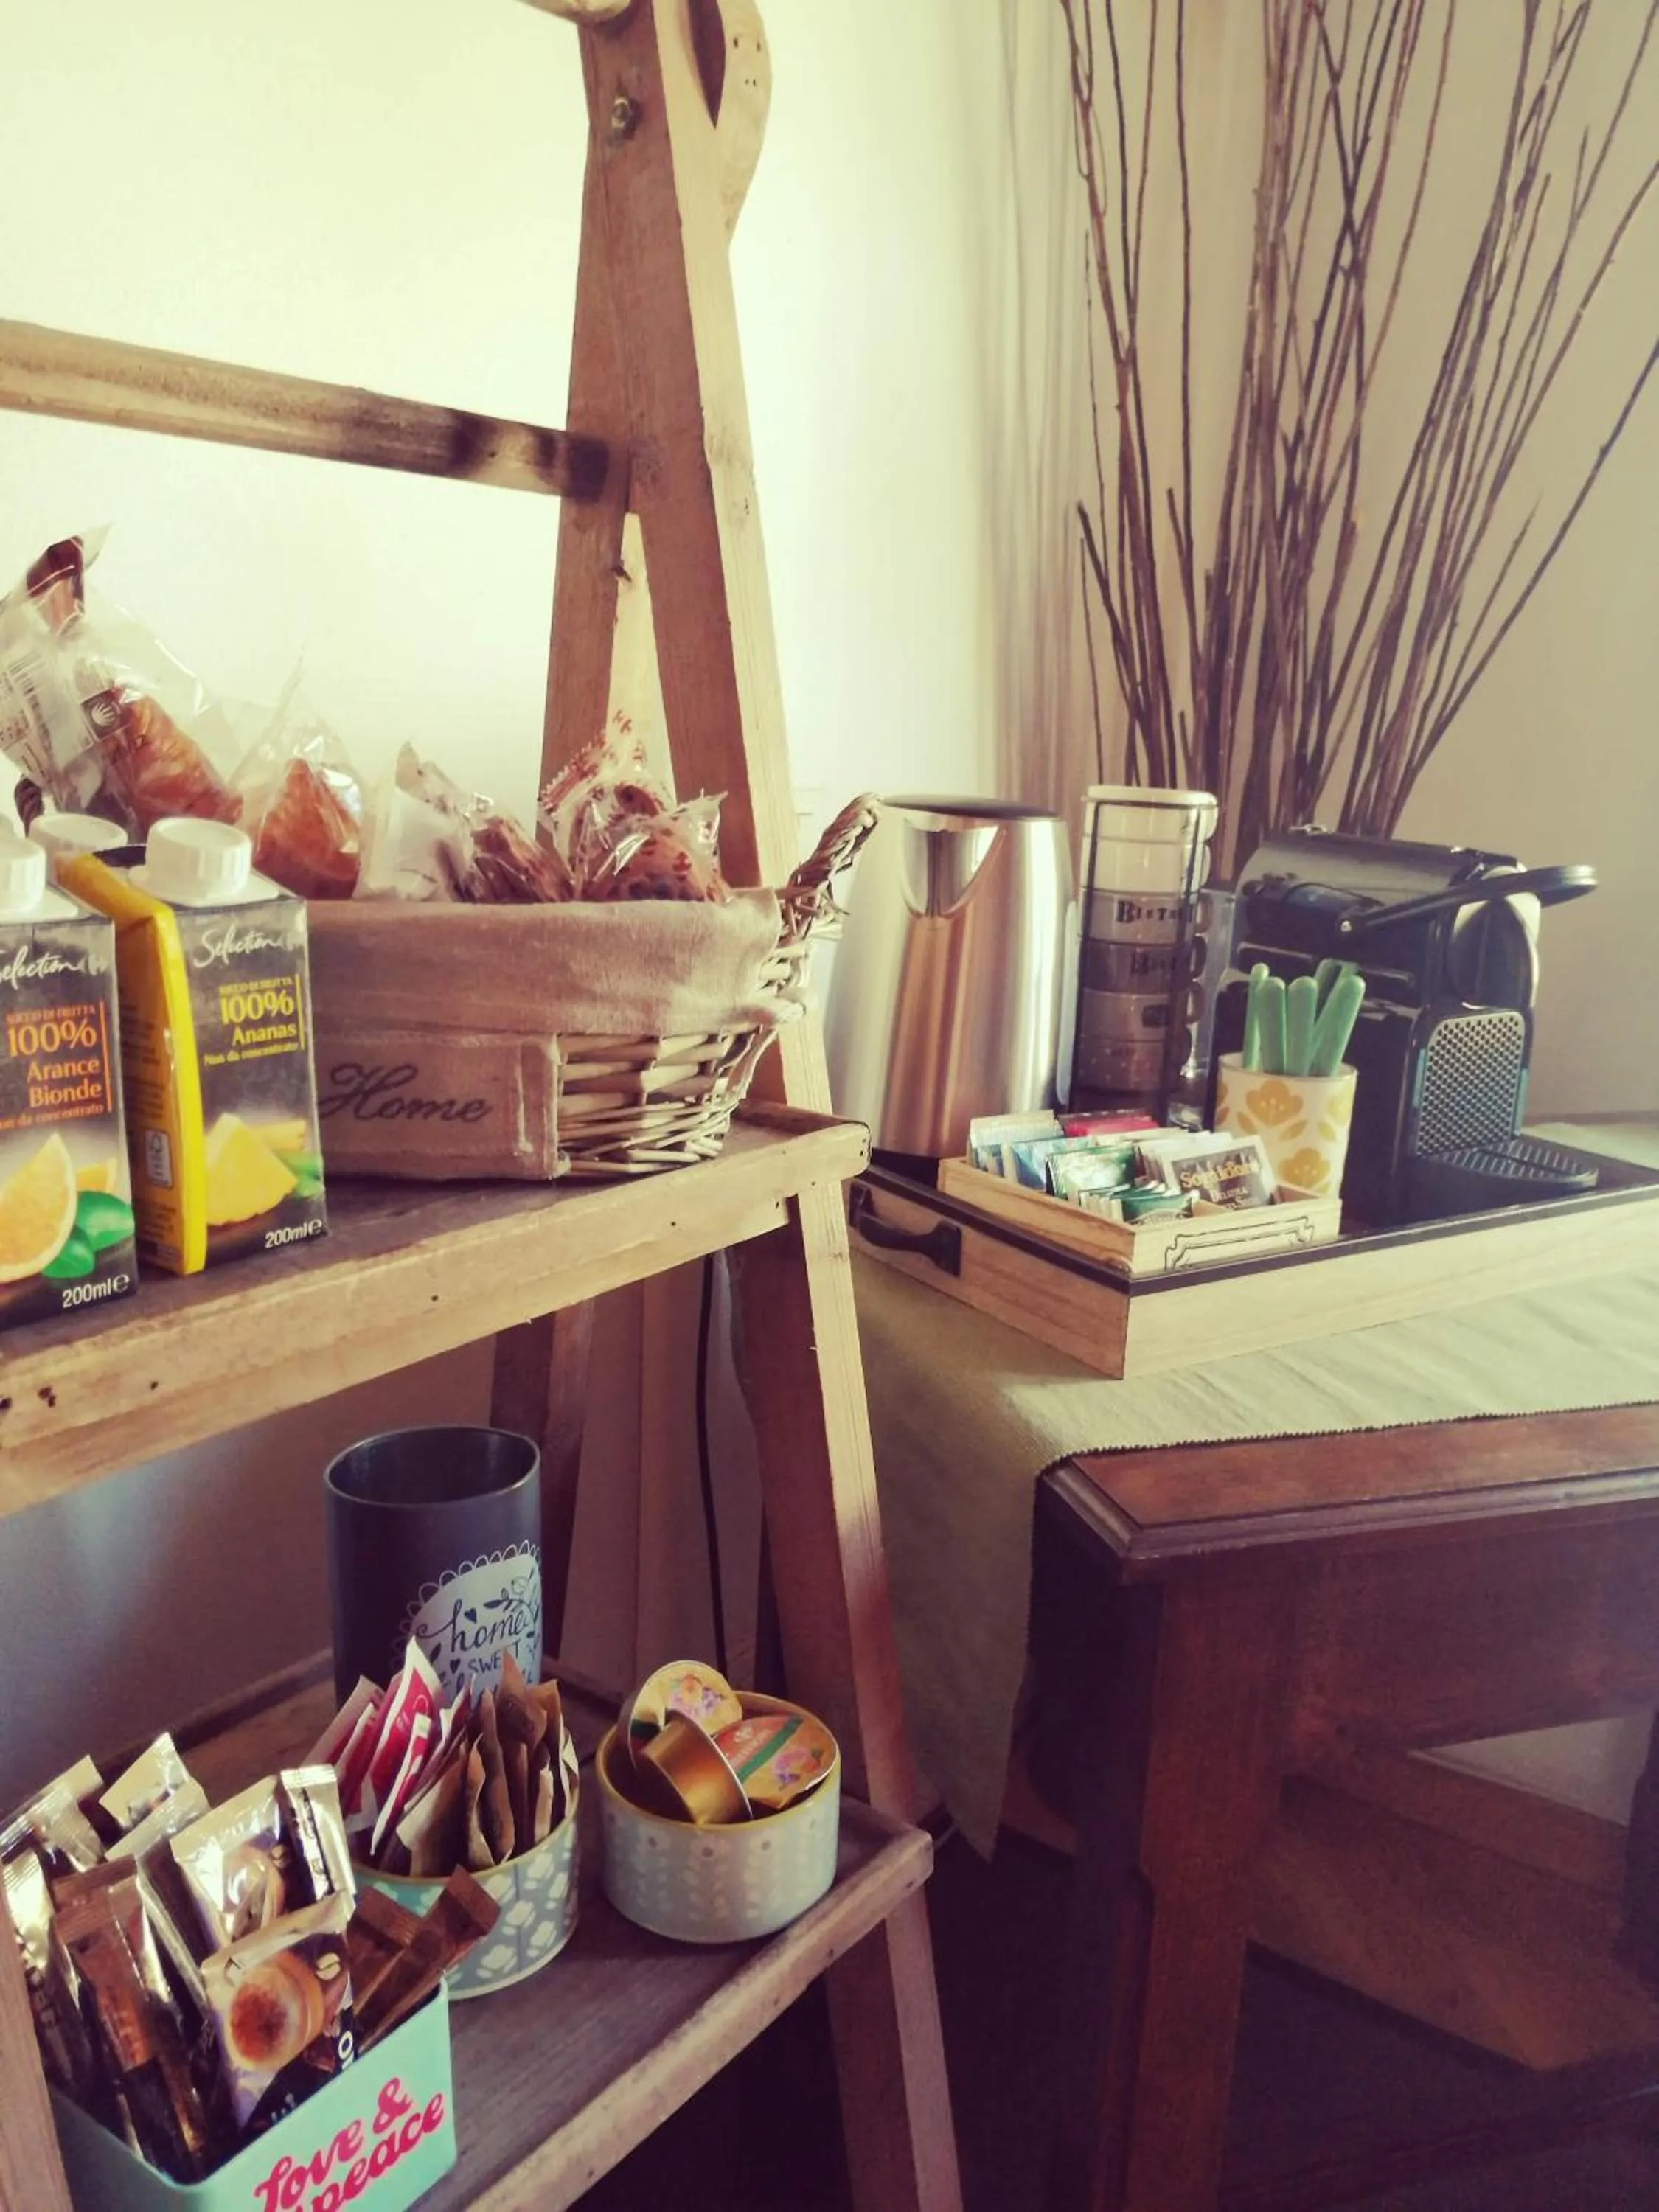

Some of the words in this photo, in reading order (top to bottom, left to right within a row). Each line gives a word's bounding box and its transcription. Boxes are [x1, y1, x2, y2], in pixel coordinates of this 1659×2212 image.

[0, 945, 78, 990] election
[220, 989, 295, 1026] 100%
[8, 1018, 97, 1058] 100%
[232, 1023, 297, 1047] Ananas
[27, 1057, 101, 1083] Arance
[29, 1078, 102, 1109] Bionde
[318, 1062, 493, 1123] Home
[417, 1598, 526, 1653] home
[254, 2118, 361, 2212] love
[372, 2076, 413, 2135] &
